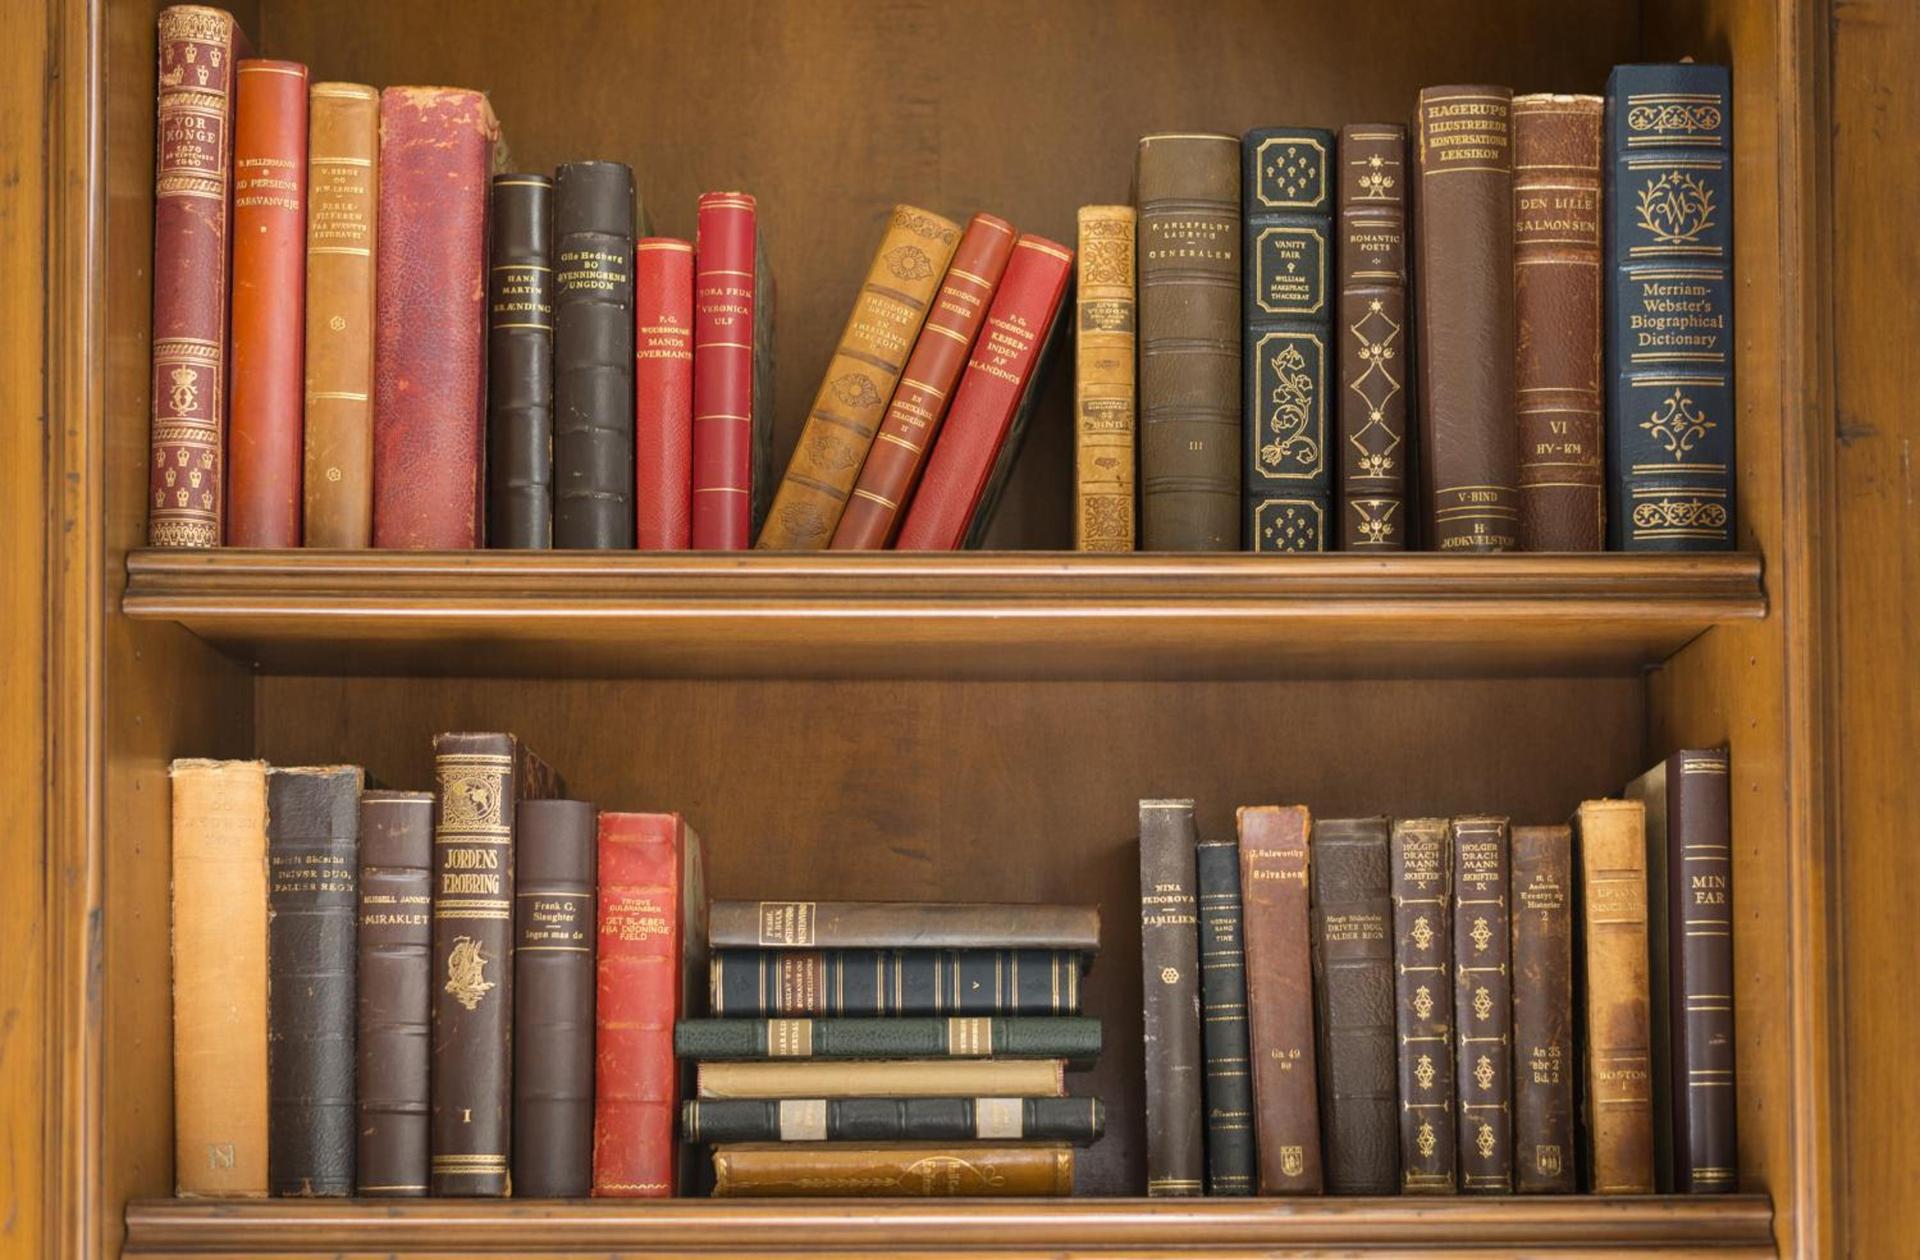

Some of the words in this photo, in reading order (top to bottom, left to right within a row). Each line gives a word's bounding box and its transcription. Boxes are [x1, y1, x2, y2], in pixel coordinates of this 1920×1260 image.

[1427, 104, 1507, 119] HAGERUPS
[175, 116, 206, 129] VOR
[166, 130, 216, 144] KONGE
[1440, 149, 1500, 161] LEKSIKON
[251, 179, 297, 191] PERSIENS
[1521, 199, 1548, 210] DEN
[1555, 198, 1594, 210] LILLE
[1516, 220, 1596, 232] SALMONSEN
[1350, 234, 1400, 243] ROMANTIC
[1274, 240, 1306, 249] VANITY
[1360, 243, 1390, 252] POETS
[581, 251, 623, 264] Hedberg
[1148, 249, 1232, 260] GENERALEN
[1280, 251, 1301, 259] FAIR
[585, 260, 598, 269] BO
[1275, 275, 1305, 283] WILLIAM
[502, 286, 542, 295] MARTIN
[569, 280, 615, 291] UNGDOM
[1643, 283, 1712, 296] Merriam-
[702, 304, 748, 315] VERONICA
[1643, 299, 1712, 313] Webster's
[714, 317, 734, 326] ULF
[1630, 314, 1724, 330] Biographical
[648, 338, 684, 347] MANDS
[1638, 333, 1717, 348] Dictionary
[987, 342, 1019, 359] INDEN
[993, 357, 1007, 366] AF
[1550, 421, 1568, 434] VI
[1462, 843, 1498, 852] HOLGER
[445, 849, 498, 870] JORDENS
[1403, 851, 1440, 860] DRACH
[1462, 852, 1499, 860] DRACH
[1404, 859, 1440, 869] MANN
[1463, 860, 1498, 869] MANN
[442, 873, 500, 894] EROBRING
[1692, 875, 1726, 888] MIN
[1155, 884, 1181, 892] NINA
[1142, 895, 1195, 905] FEDOROVA
[1694, 891, 1725, 904] FAR
[534, 900, 561, 911] Frank
[365, 914, 429, 925] MIRAKLET
[533, 911, 576, 922] Slaughter
[1142, 915, 1197, 925] FAMILIEN
[1541, 910, 1549, 921] 2
[1599, 1071, 1648, 1081] BOSTON
